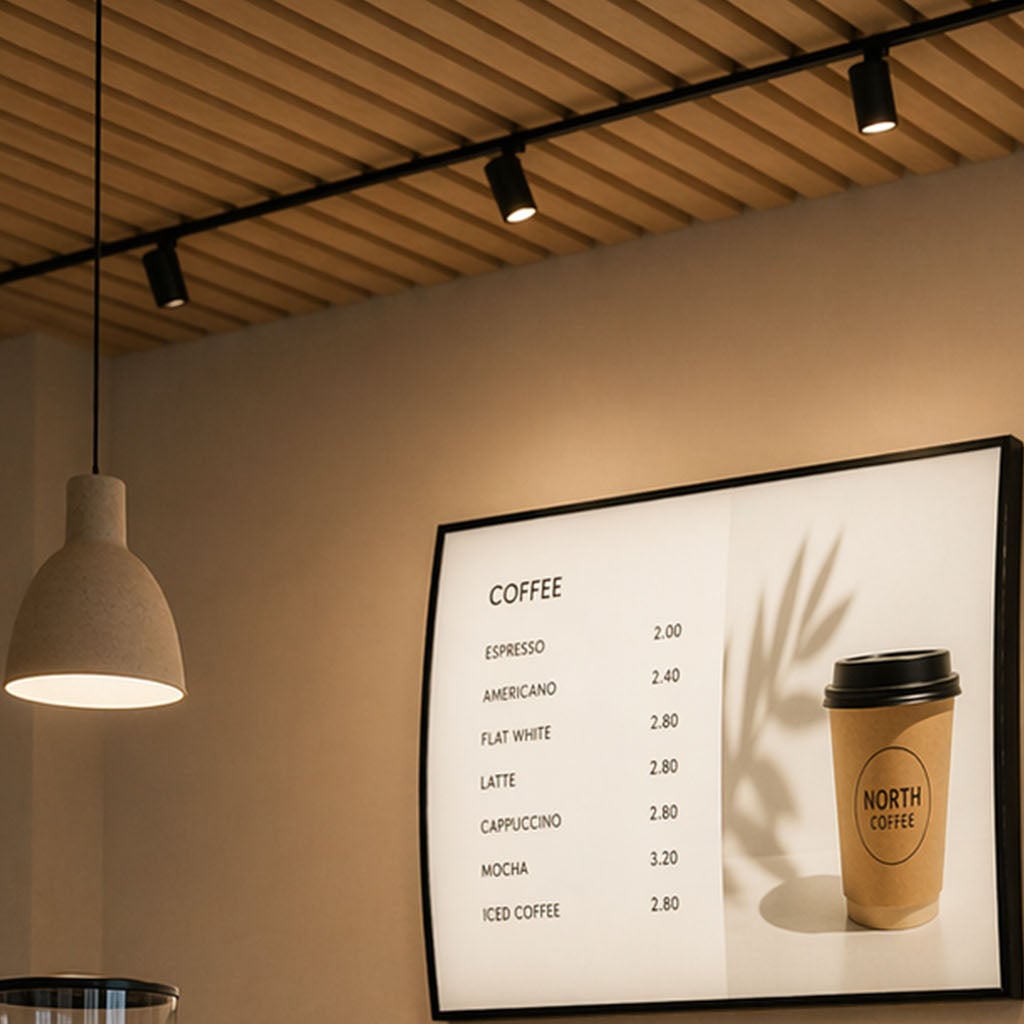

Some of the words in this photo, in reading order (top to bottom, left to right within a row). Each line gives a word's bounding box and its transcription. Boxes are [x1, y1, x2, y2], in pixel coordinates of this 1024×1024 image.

[489, 576, 563, 606] COFFEE
[653, 622, 683, 641] 2.00
[485, 639, 546, 661] ESPRESSO
[651, 667, 681, 685] 2.40
[482, 680, 557, 703] AMERICANO
[650, 712, 679, 730] 2.80
[481, 729, 510, 746] FLAT
[512, 724, 551, 743] WHITE
[649, 758, 679, 776] 2.80
[480, 772, 516, 791] LATTE
[863, 786, 921, 811] NORTH
[649, 803, 679, 821] 2.80
[870, 812, 914, 831] COFFEE
[480, 812, 562, 835] CAPPUCCINO
[650, 849, 679, 867] 3.20
[481, 861, 529, 878] MOCHA
[482, 906, 511, 922] ICED
[513, 902, 561, 921] COFFEE
[651, 895, 680, 912] 2.80
